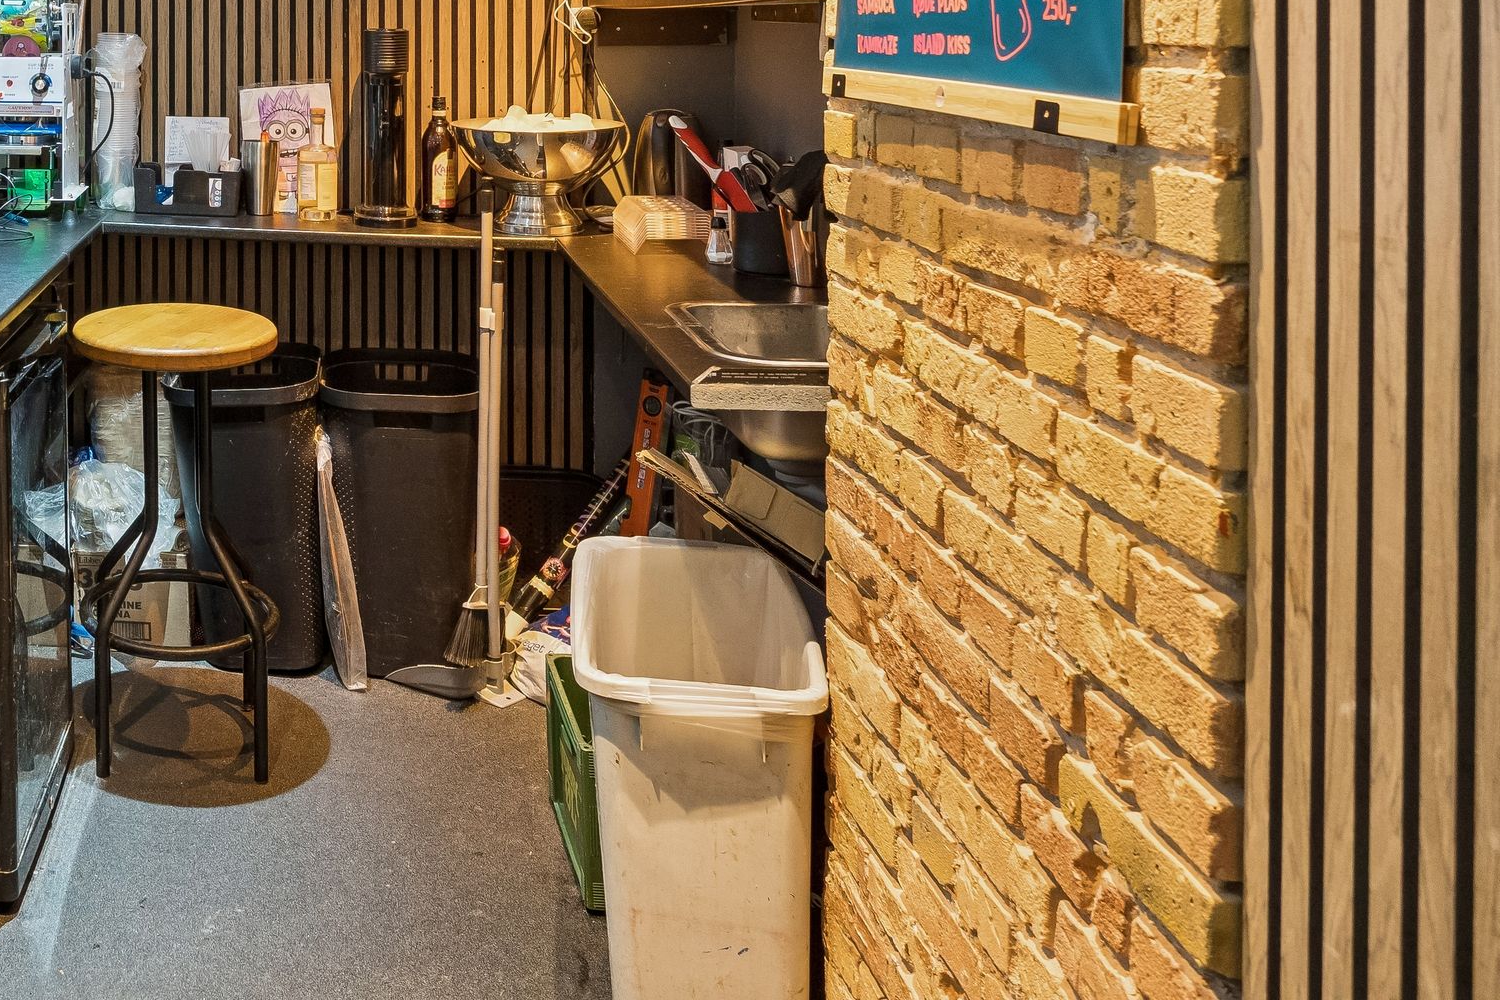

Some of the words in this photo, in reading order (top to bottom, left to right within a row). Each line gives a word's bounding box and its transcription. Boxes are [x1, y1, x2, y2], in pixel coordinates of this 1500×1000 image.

[857, 34, 898, 56] KAMIKAZE
[913, 33, 945, 56] ISLAND
[946, 35, 971, 56] KISS
